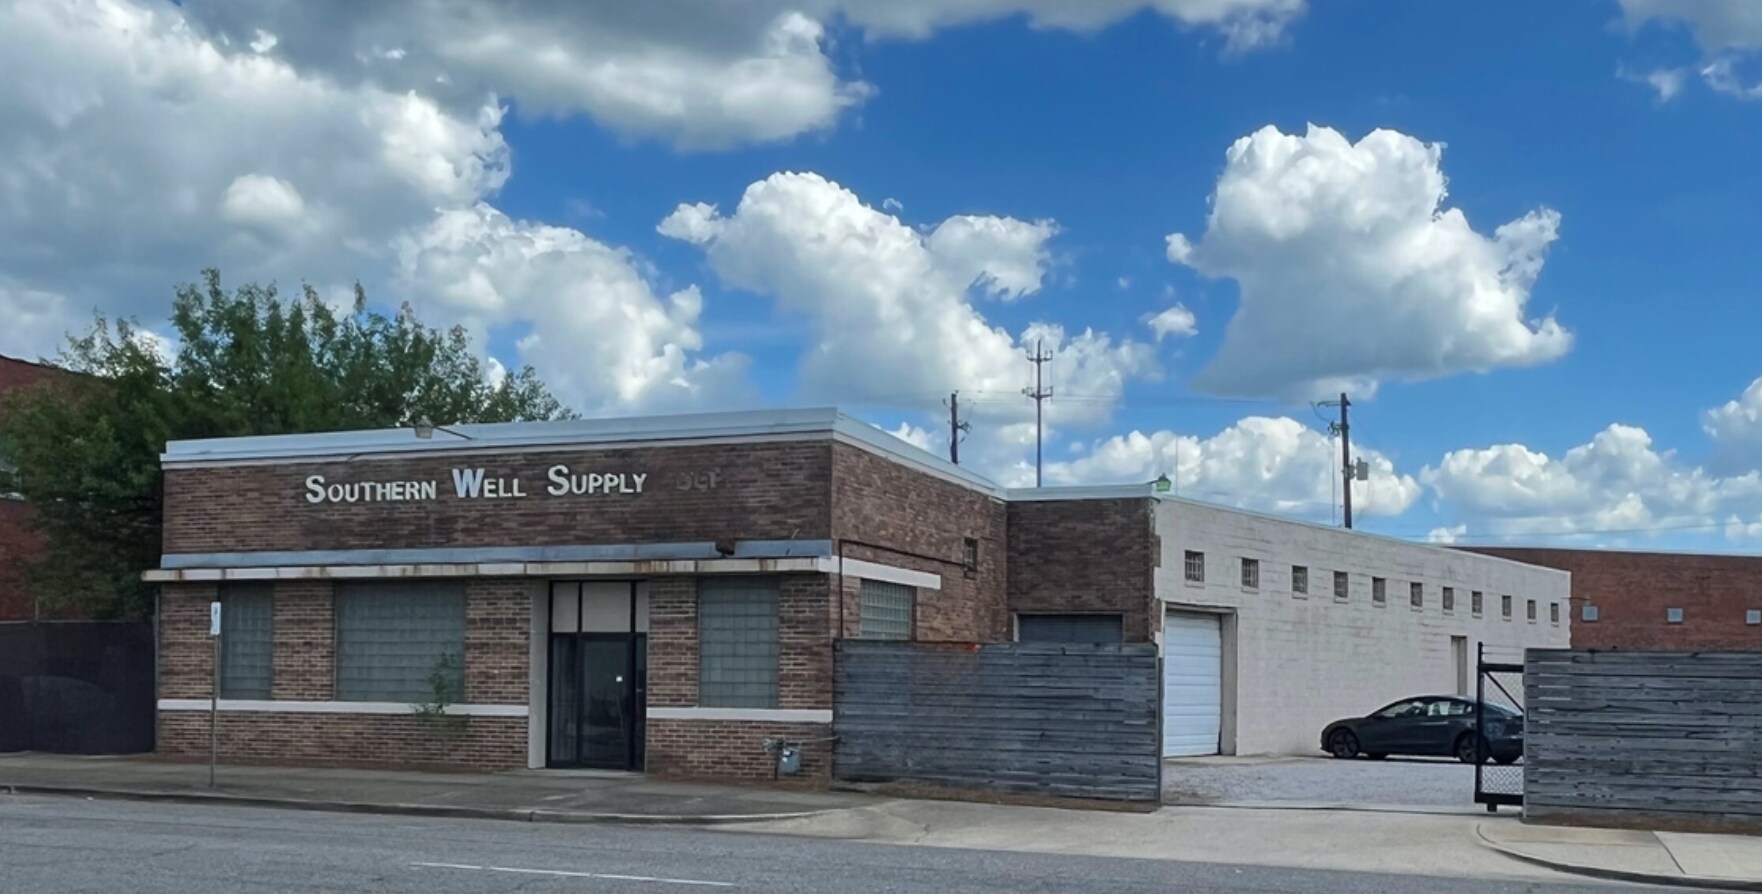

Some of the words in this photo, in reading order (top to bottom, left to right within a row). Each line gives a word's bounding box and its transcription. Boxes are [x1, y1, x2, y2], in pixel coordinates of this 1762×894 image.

[305, 474, 437, 504] SOUTHERN
[451, 467, 527, 499] WELL
[546, 463, 647, 496] SUPPLY
